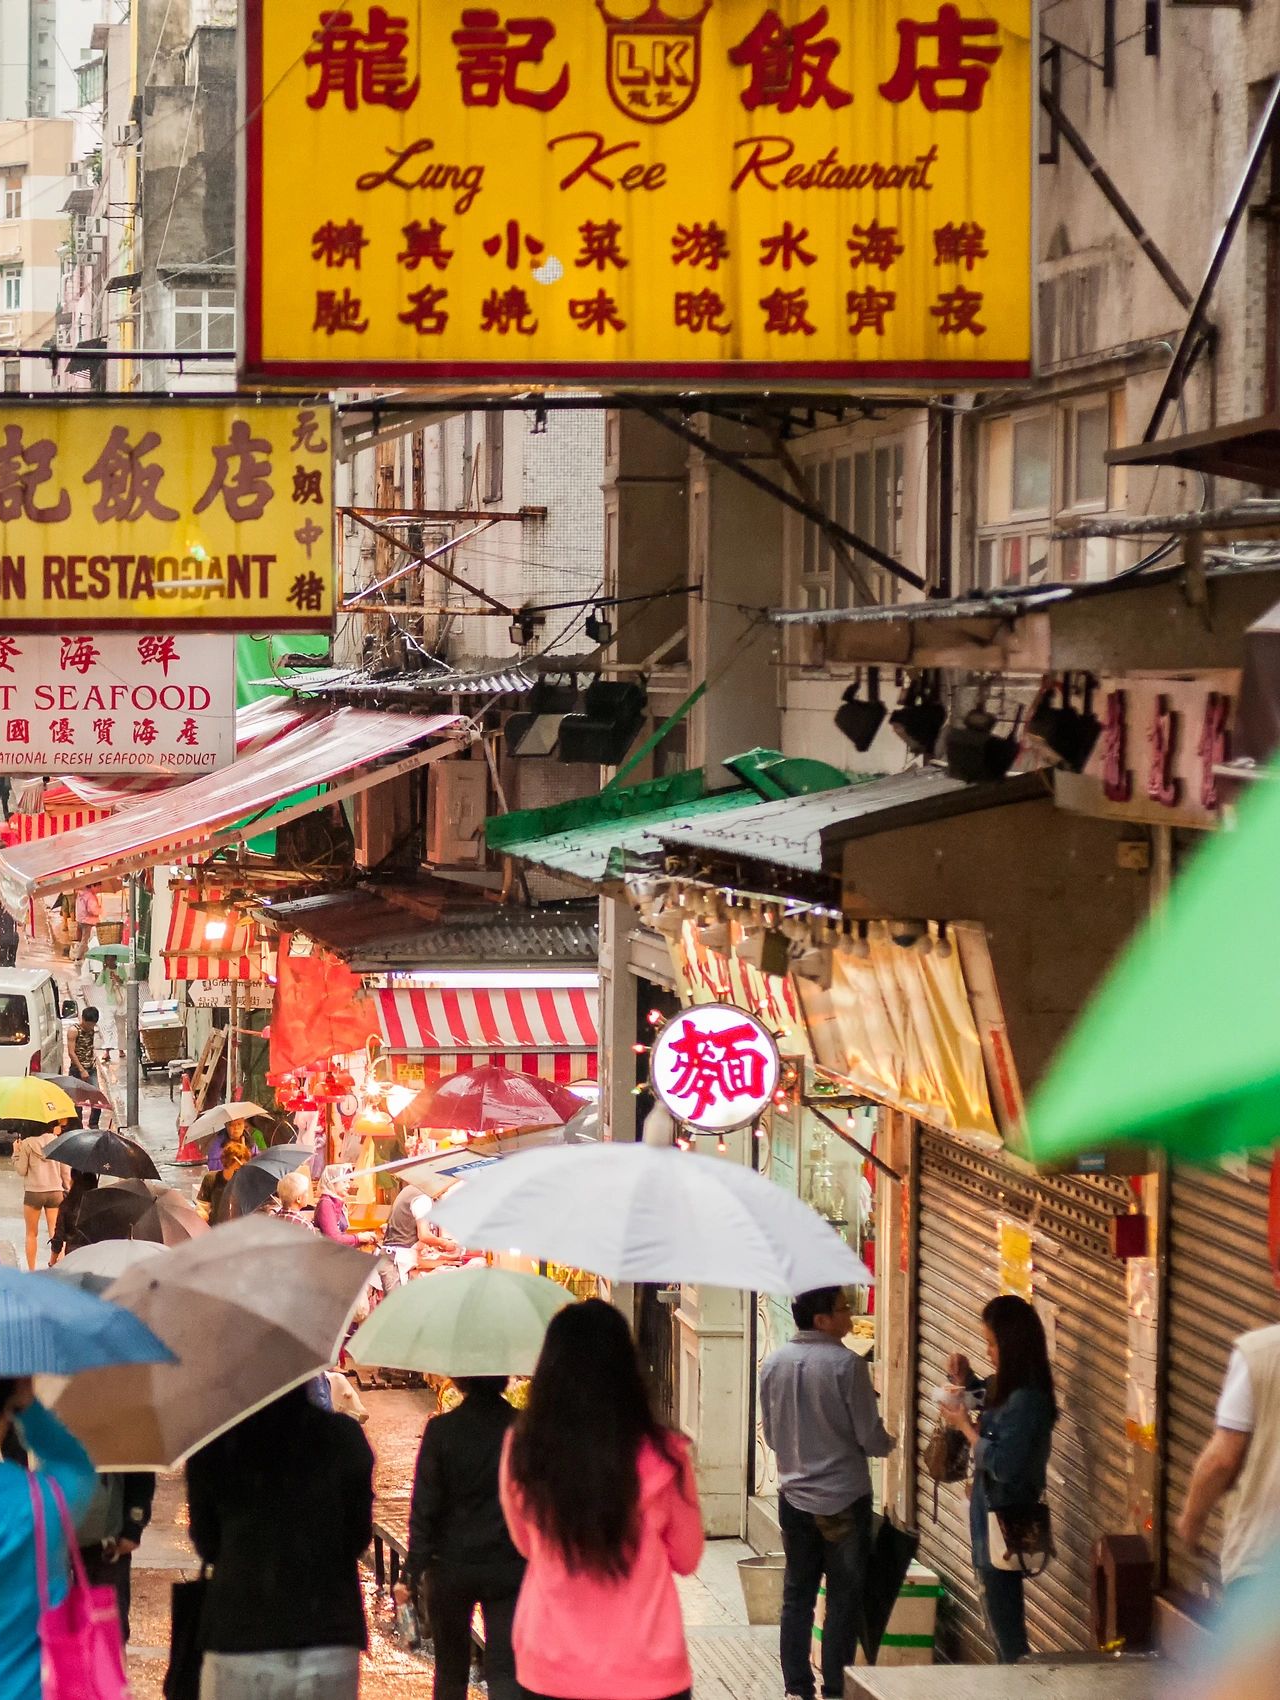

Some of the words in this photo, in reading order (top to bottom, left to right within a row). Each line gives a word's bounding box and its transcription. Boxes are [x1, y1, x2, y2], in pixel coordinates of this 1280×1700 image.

[302, 5, 570, 113] 龍記
[728, 3, 1004, 114] 飯店
[616, 40, 693, 87] LK
[356, 138, 484, 214] Lung
[547, 131, 666, 192] Kee
[730, 135, 938, 193] Restaurant
[34, 684, 212, 712] SEAFOOD
[54, 752, 93, 766] FRESH
[98, 752, 154, 766] SEAFOOD
[159, 752, 217, 767] PRODUCT
